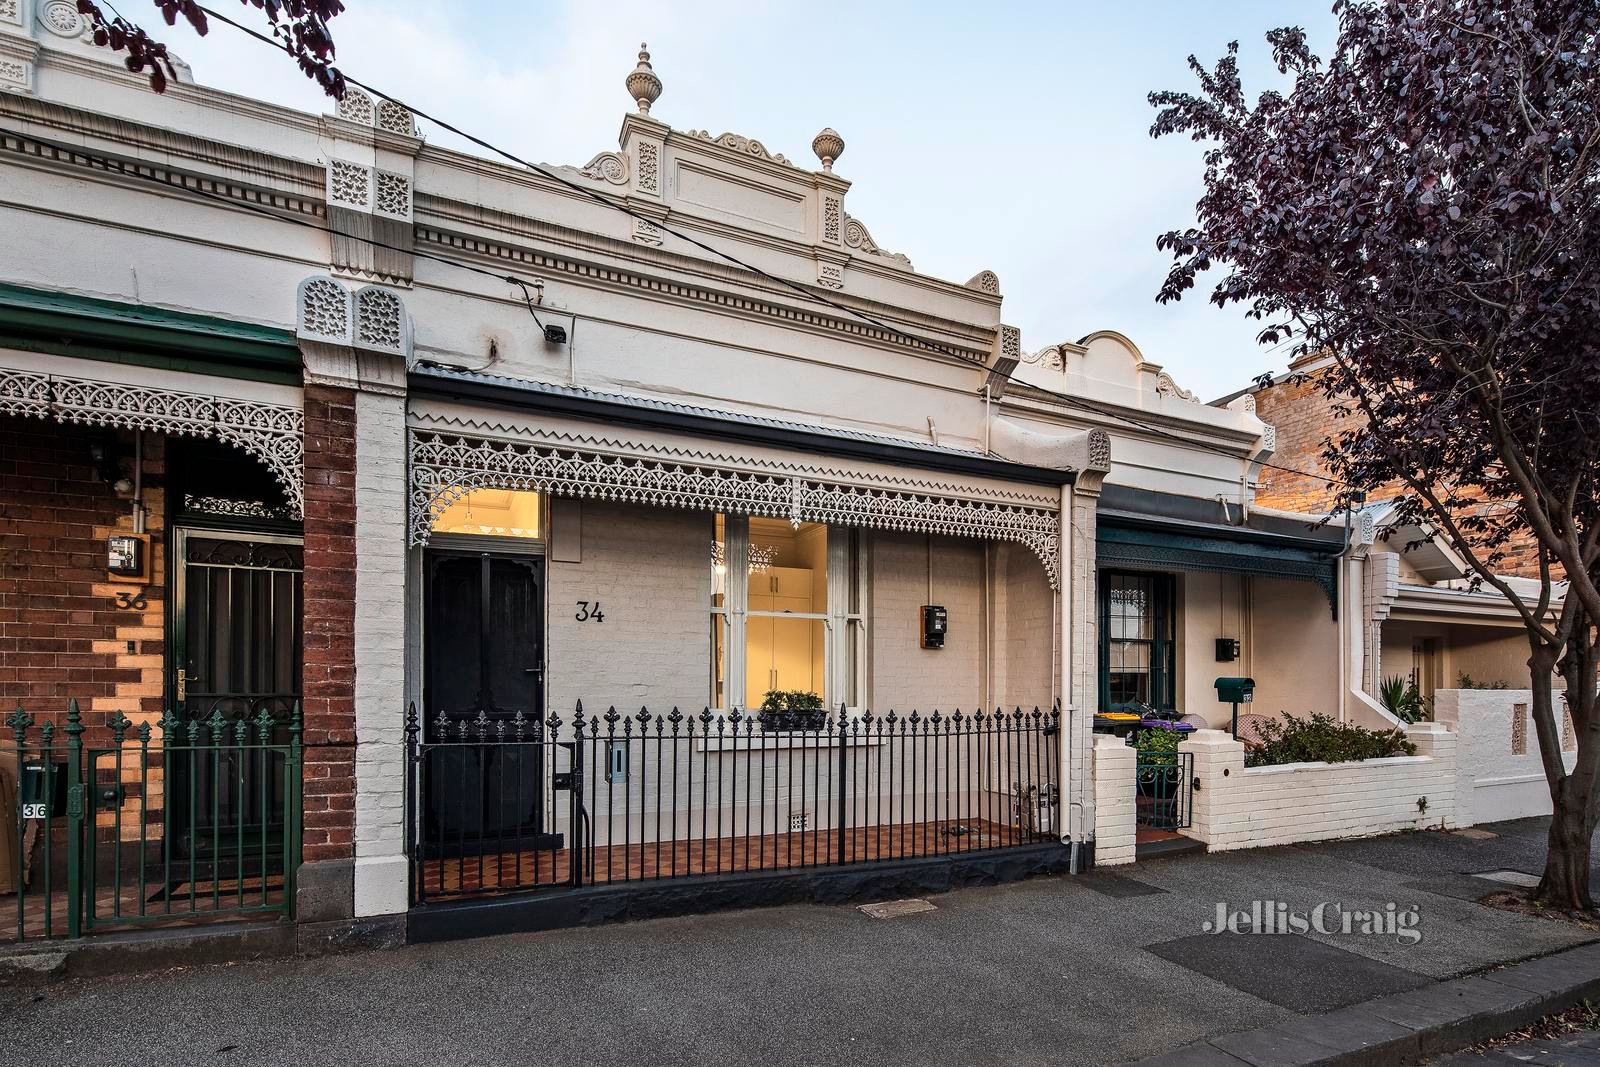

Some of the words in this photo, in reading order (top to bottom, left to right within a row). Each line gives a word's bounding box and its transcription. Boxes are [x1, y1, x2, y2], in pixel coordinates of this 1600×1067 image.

[113, 591, 147, 610] 36
[575, 600, 605, 623] 34
[24, 805, 46, 817] 36
